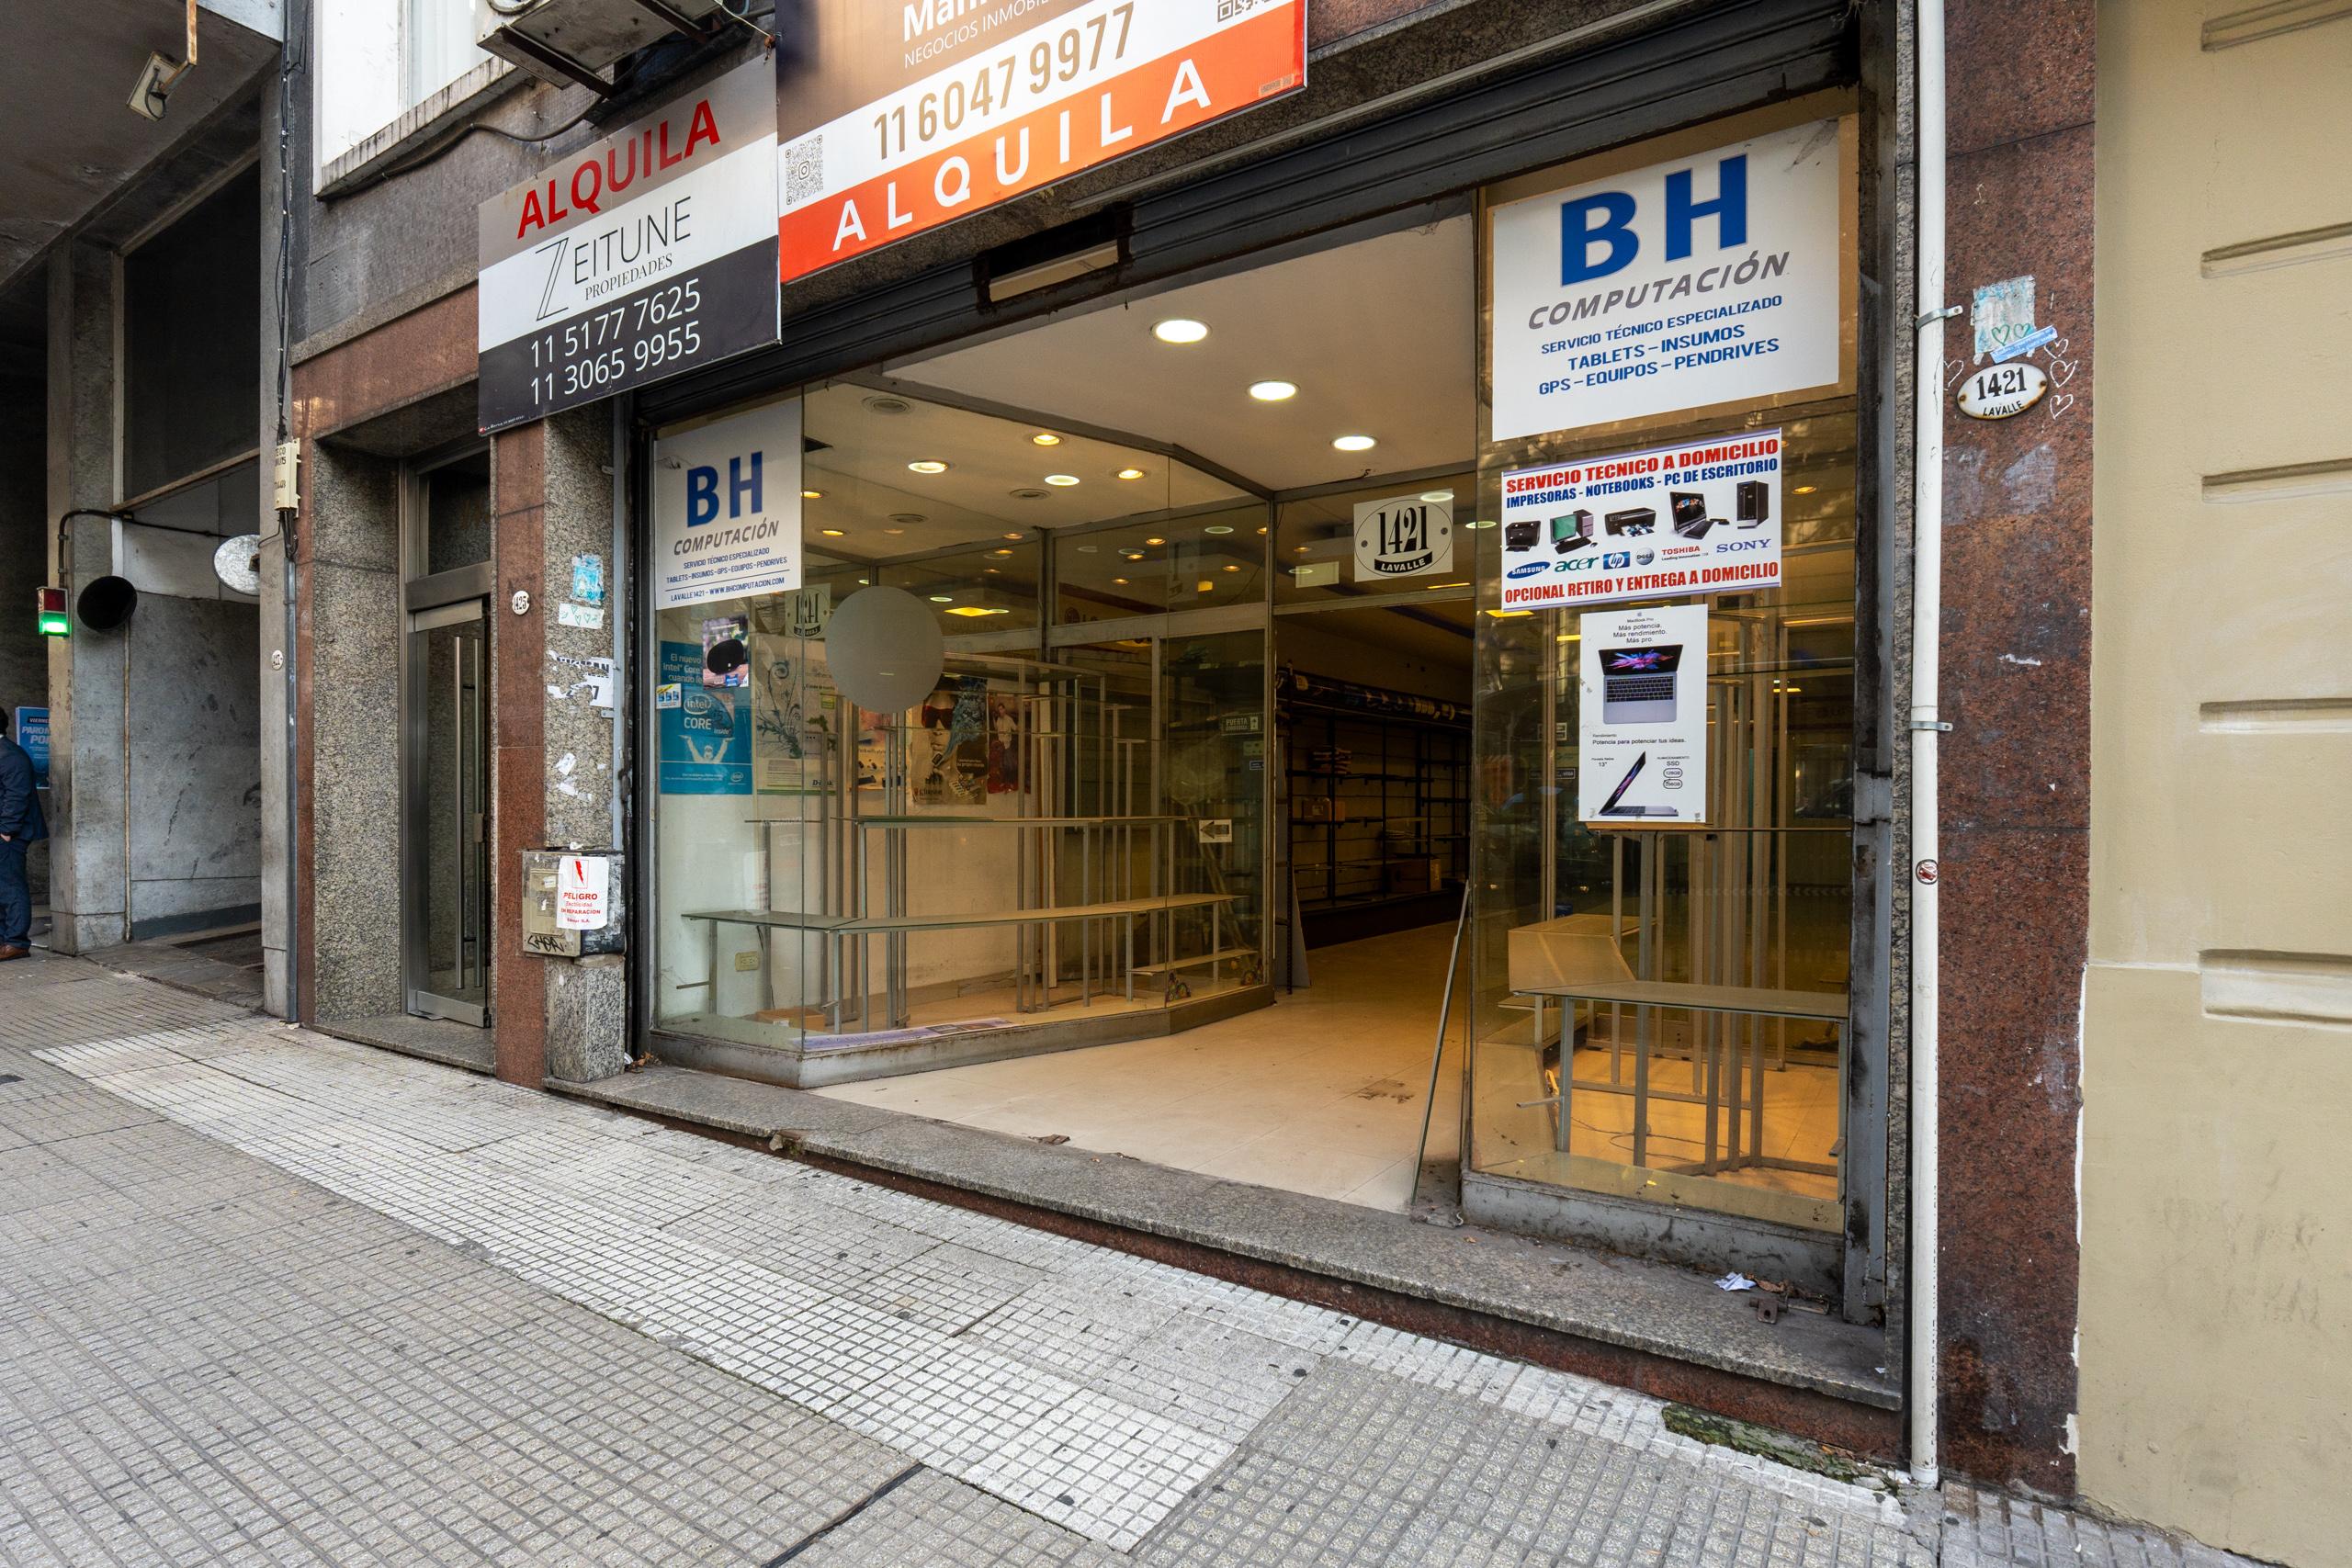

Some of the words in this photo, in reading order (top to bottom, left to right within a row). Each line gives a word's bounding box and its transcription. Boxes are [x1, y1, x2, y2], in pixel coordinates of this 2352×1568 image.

[905, 20, 978, 69] NEGOCIOS
[874, 106, 907, 161] 11
[918, 55, 1017, 142] 6047
[1029, 2, 1135, 95] 9977
[516, 99, 721, 239] ALQUILA
[831, 59, 1213, 252] ALQUILA
[1561, 153, 1748, 288] BH
[535, 196, 692, 321] ZEITUNE
[584, 254, 673, 301] PROPIEDADES
[1528, 250, 1791, 331] COMPUTACIÓN
[531, 335, 553, 367] 11
[564, 307, 628, 357] 5177
[634, 279, 701, 333] 7625
[1541, 333, 1601, 355] SERVICIO
[1605, 320, 1664, 342] TÉCNICO
[1668, 295, 1783, 329] ESPECIALIZADO
[531, 372, 553, 405] 11
[564, 348, 626, 395] 3065
[635, 321, 701, 372] 9955
[1538, 378, 1572, 396] GPS
[1586, 360, 1658, 388] EQUIPOS
[1674, 337, 1781, 370] PENDRIVES
[1567, 344, 1645, 371] TABLETS
[1661, 324, 1746, 354] INSUMOS
[1976, 367, 2028, 401] 1421
[1983, 400, 2024, 416] LAVALLE
[687, 451, 763, 528] BH
[1506, 469, 1581, 494] SERVICIO
[1584, 457, 1659, 483] TECNICO
[1663, 455, 1675, 469] A
[1679, 438, 1779, 468] DOMICILIO
[1506, 489, 1577, 509] IMPRESORAS
[1586, 476, 1655, 498] NOTEBOOKS
[1664, 472, 1681, 487] PC
[1683, 469, 1699, 483] DE
[1702, 457, 1779, 482] ESCRITORIO
[673, 517, 780, 556] COMPUTACIÓN
[1377, 506, 1430, 556] 1421
[666, 574, 688, 583] TABLETS
[691, 570, 714, 580] INSUMOS
[731, 563, 753, 572] EQUIPOS
[757, 557, 787, 568] PENDRIVES
[684, 559, 706, 570] SERVICIO
[707, 555, 728, 566] TÉCNICO
[729, 547, 770, 560] ESPECIALIZADO
[1380, 558, 1426, 571] LAVALLE
[1511, 565, 1545, 575] SAMSUNG
[1554, 557, 1600, 572] acer
[1610, 553, 1623, 568] hp
[1661, 546, 1701, 556] TOSHIBA
[1716, 538, 1771, 553] SONY
[513, 595, 526, 611] 1425
[671, 592, 693, 602] LAVALLE
[694, 591, 705, 600] 1421
[1505, 582, 1565, 604] OPCIONAL
[1567, 576, 1613, 596] RETIRO
[1616, 575, 1624, 592] Y
[1627, 571, 1686, 591] ENTREGA
[1689, 570, 1699, 584] A
[1702, 561, 1779, 583] DOMICILIO
[1634, 623, 1662, 631] potencia.
[668, 674, 695, 683] cuando
[671, 653, 677, 661] El
[679, 656, 701, 664] nuevo
[684, 716, 712, 730] CORE
[563, 892, 598, 900] PELIGRO
